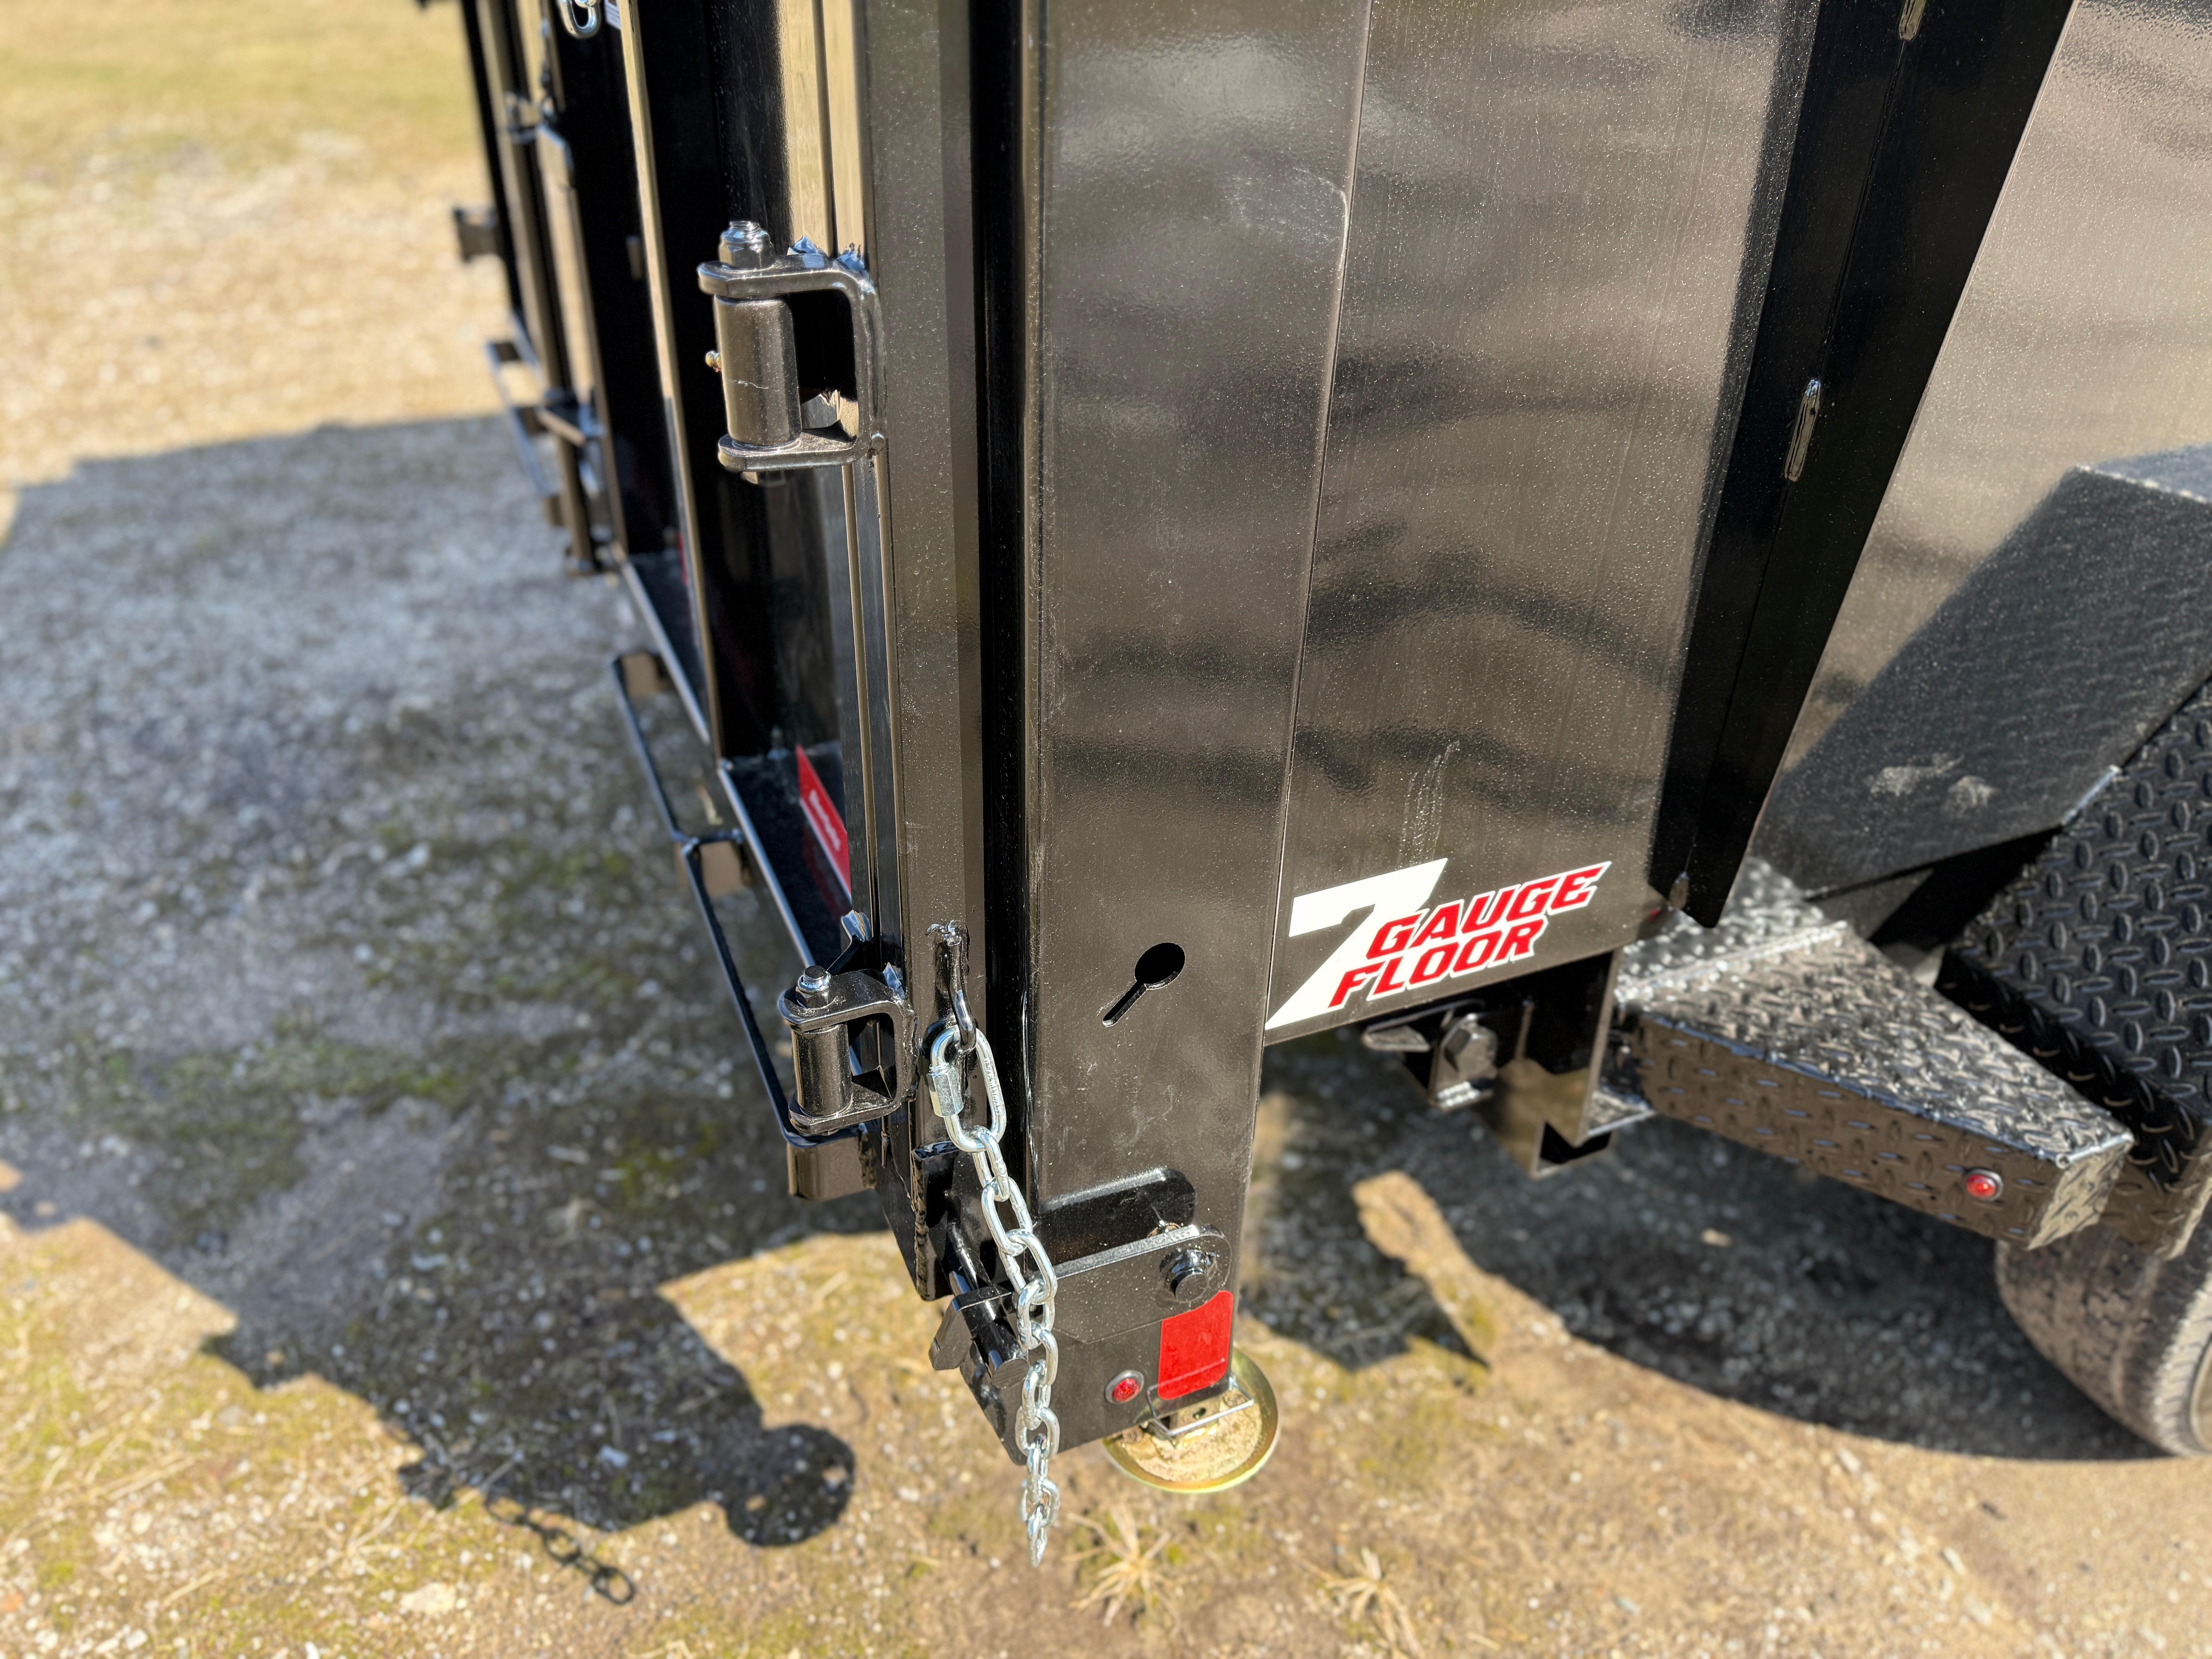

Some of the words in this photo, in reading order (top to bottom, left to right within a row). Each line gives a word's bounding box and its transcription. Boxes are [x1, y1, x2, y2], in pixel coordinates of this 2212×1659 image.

[1265, 858, 1448, 1030] 7
[1366, 864, 1605, 960] GAUGE
[1328, 919, 1543, 1007] FLOOR
